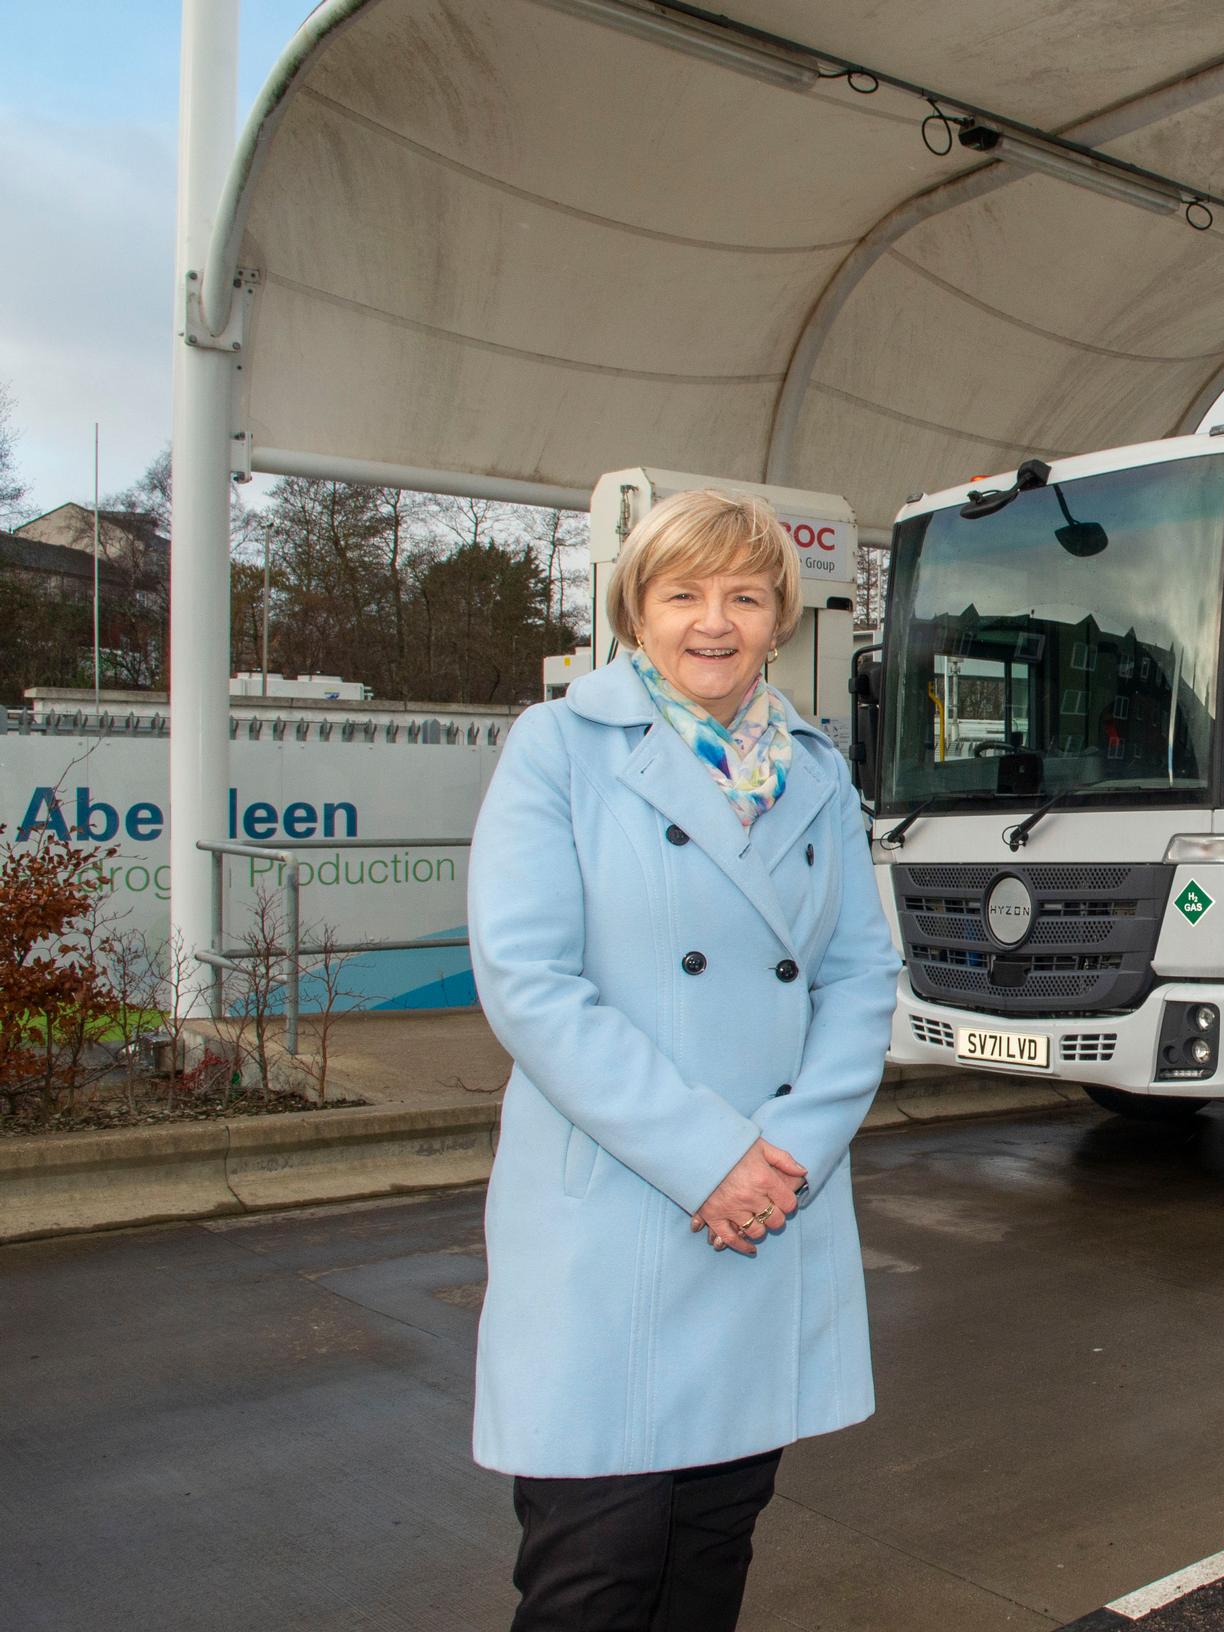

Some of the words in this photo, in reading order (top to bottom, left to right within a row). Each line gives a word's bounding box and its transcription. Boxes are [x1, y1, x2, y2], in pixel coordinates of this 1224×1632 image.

[805, 557, 835, 573] Group
[248, 852, 456, 888] Production
[990, 905, 1030, 916] HYZON
[1184, 903, 1203, 912] GAS
[968, 1033, 1002, 1057] SV71
[1006, 1036, 1037, 1060] LVD
